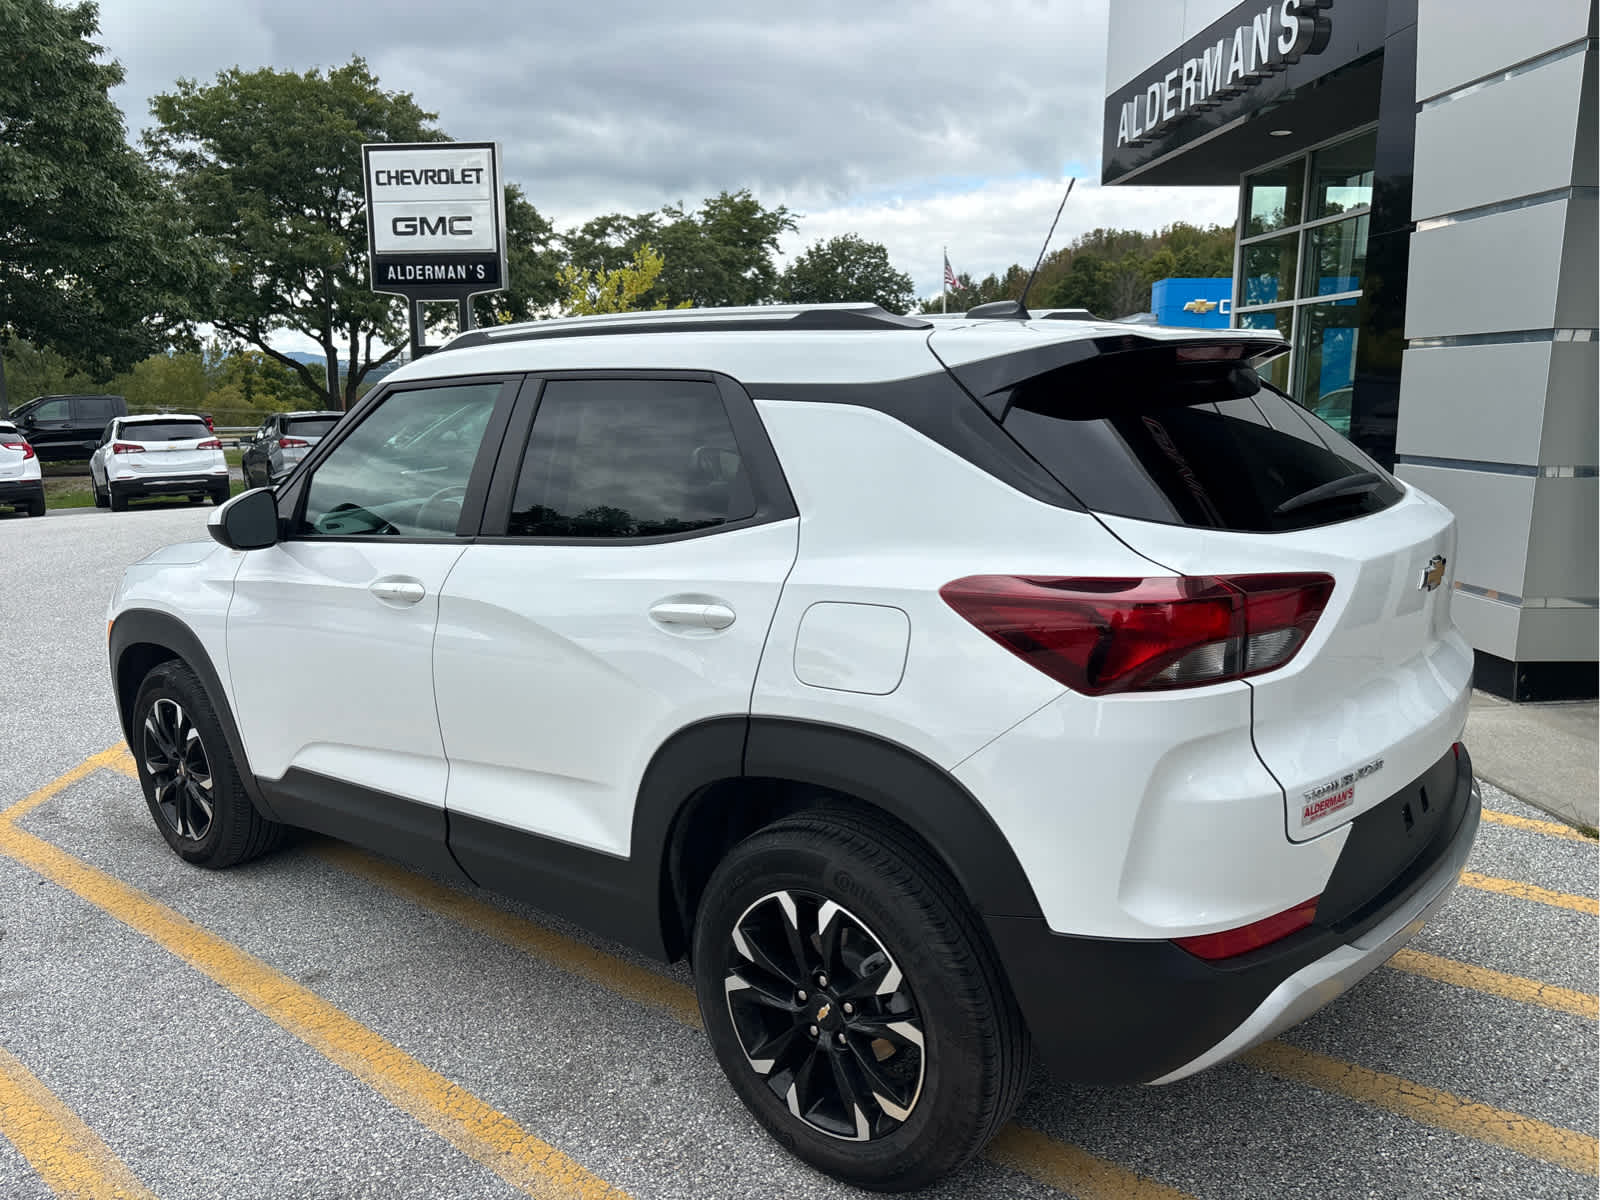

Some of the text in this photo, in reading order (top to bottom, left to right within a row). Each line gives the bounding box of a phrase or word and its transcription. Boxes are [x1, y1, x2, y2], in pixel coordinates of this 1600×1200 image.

[375, 167, 484, 186] CHEVROLET
[391, 215, 473, 236] GMC
[387, 264, 486, 280] ALDERMAN'S
[1303, 787, 1354, 818] ALDERMAN'S
